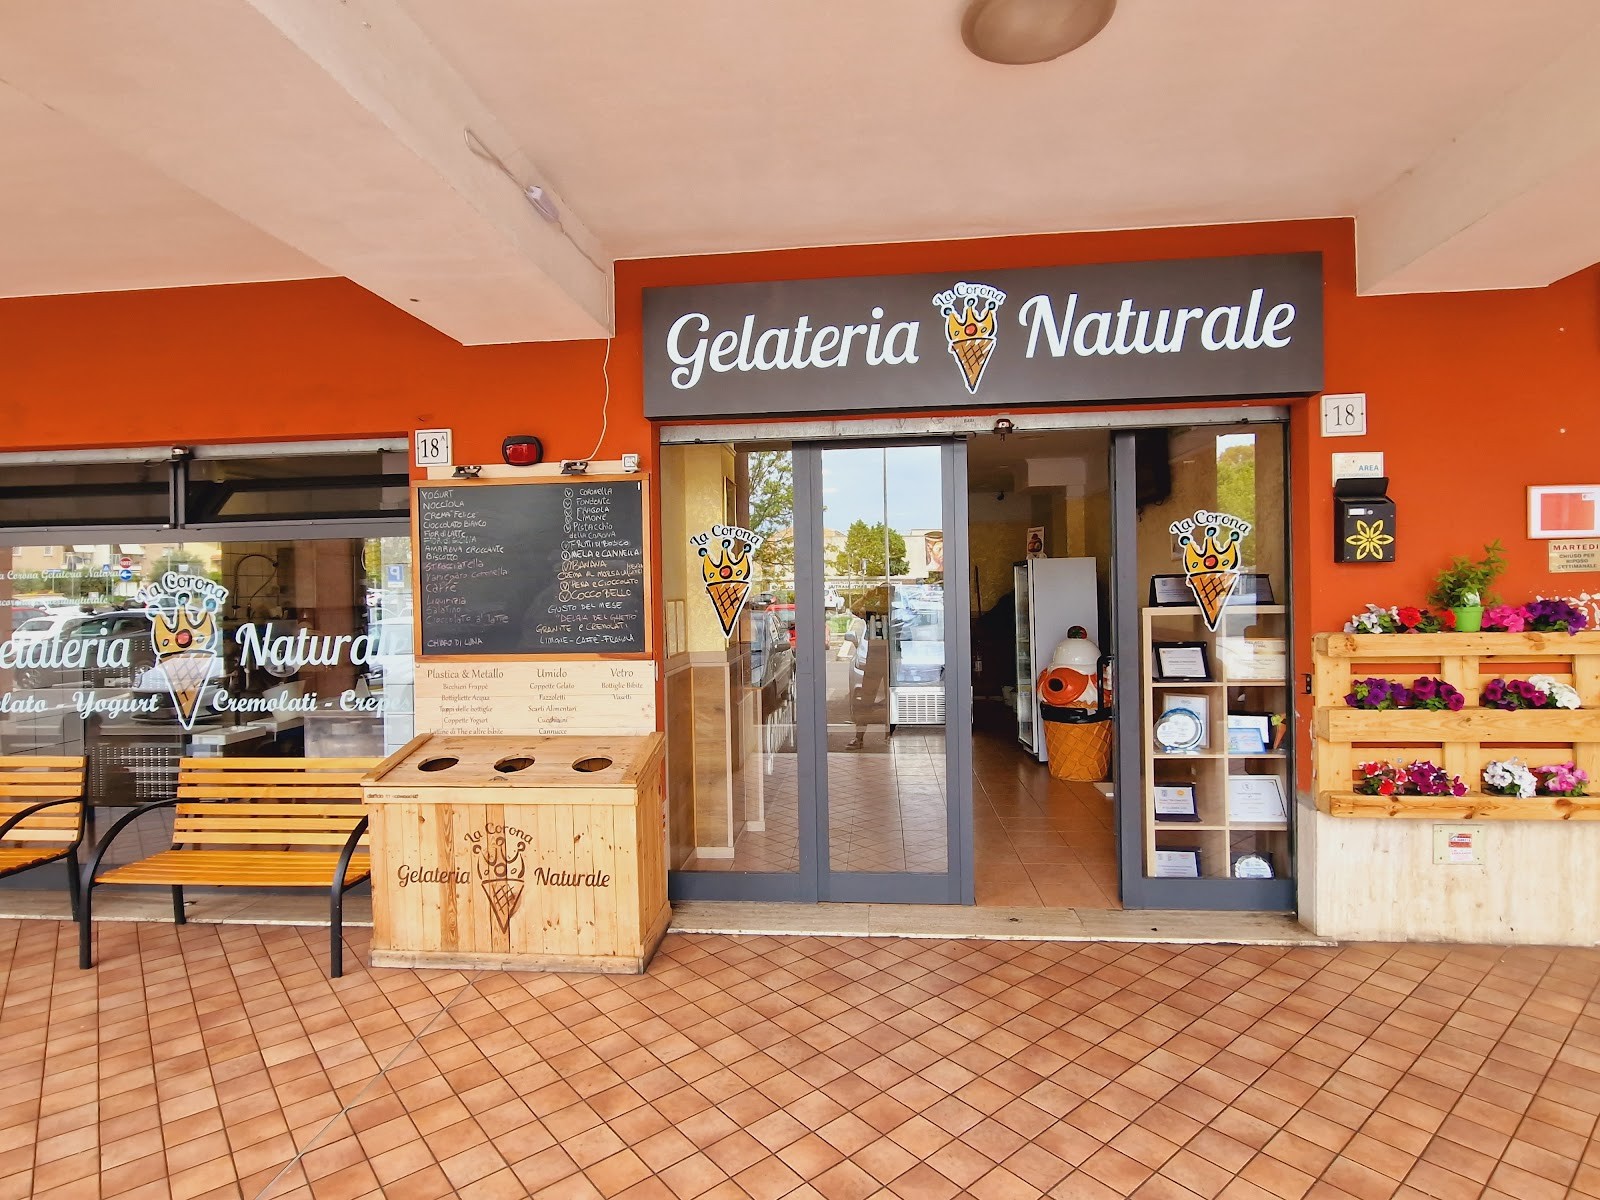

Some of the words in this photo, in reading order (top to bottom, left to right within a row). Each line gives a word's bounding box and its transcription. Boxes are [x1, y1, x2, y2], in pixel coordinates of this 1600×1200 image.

[934, 289, 953, 306] La
[955, 283, 1004, 301] Corona
[666, 306, 920, 389] Gelateria
[1018, 288, 1295, 358] Naturale
[1333, 403, 1356, 426] 18
[421, 438, 439, 458] 18
[421, 489, 454, 500] YOGURT
[423, 500, 464, 510] NOCCIOLA
[1170, 520, 1192, 534] La
[1195, 512, 1249, 533] Corona
[690, 533, 709, 546] La
[712, 525, 760, 545] Corona
[7, 570, 38, 580] Corona
[41, 569, 82, 581] Gelateria
[164, 574, 226, 600] Corona
[0, 627, 130, 669] elateria
[427, 668, 459, 679] Plastica
[461, 669, 470, 679] &
[471, 668, 504, 679] Metallo
[537, 668, 568, 678] Umido
[610, 668, 634, 678] Vetro
[0, 691, 48, 713] lato
[72, 691, 160, 719] Yogurt
[212, 689, 318, 712] Cremolati
[464, 830, 483, 844] La
[484, 822, 534, 845] Corona
[397, 864, 471, 888] Gelateria
[534, 866, 611, 888] Naturale
